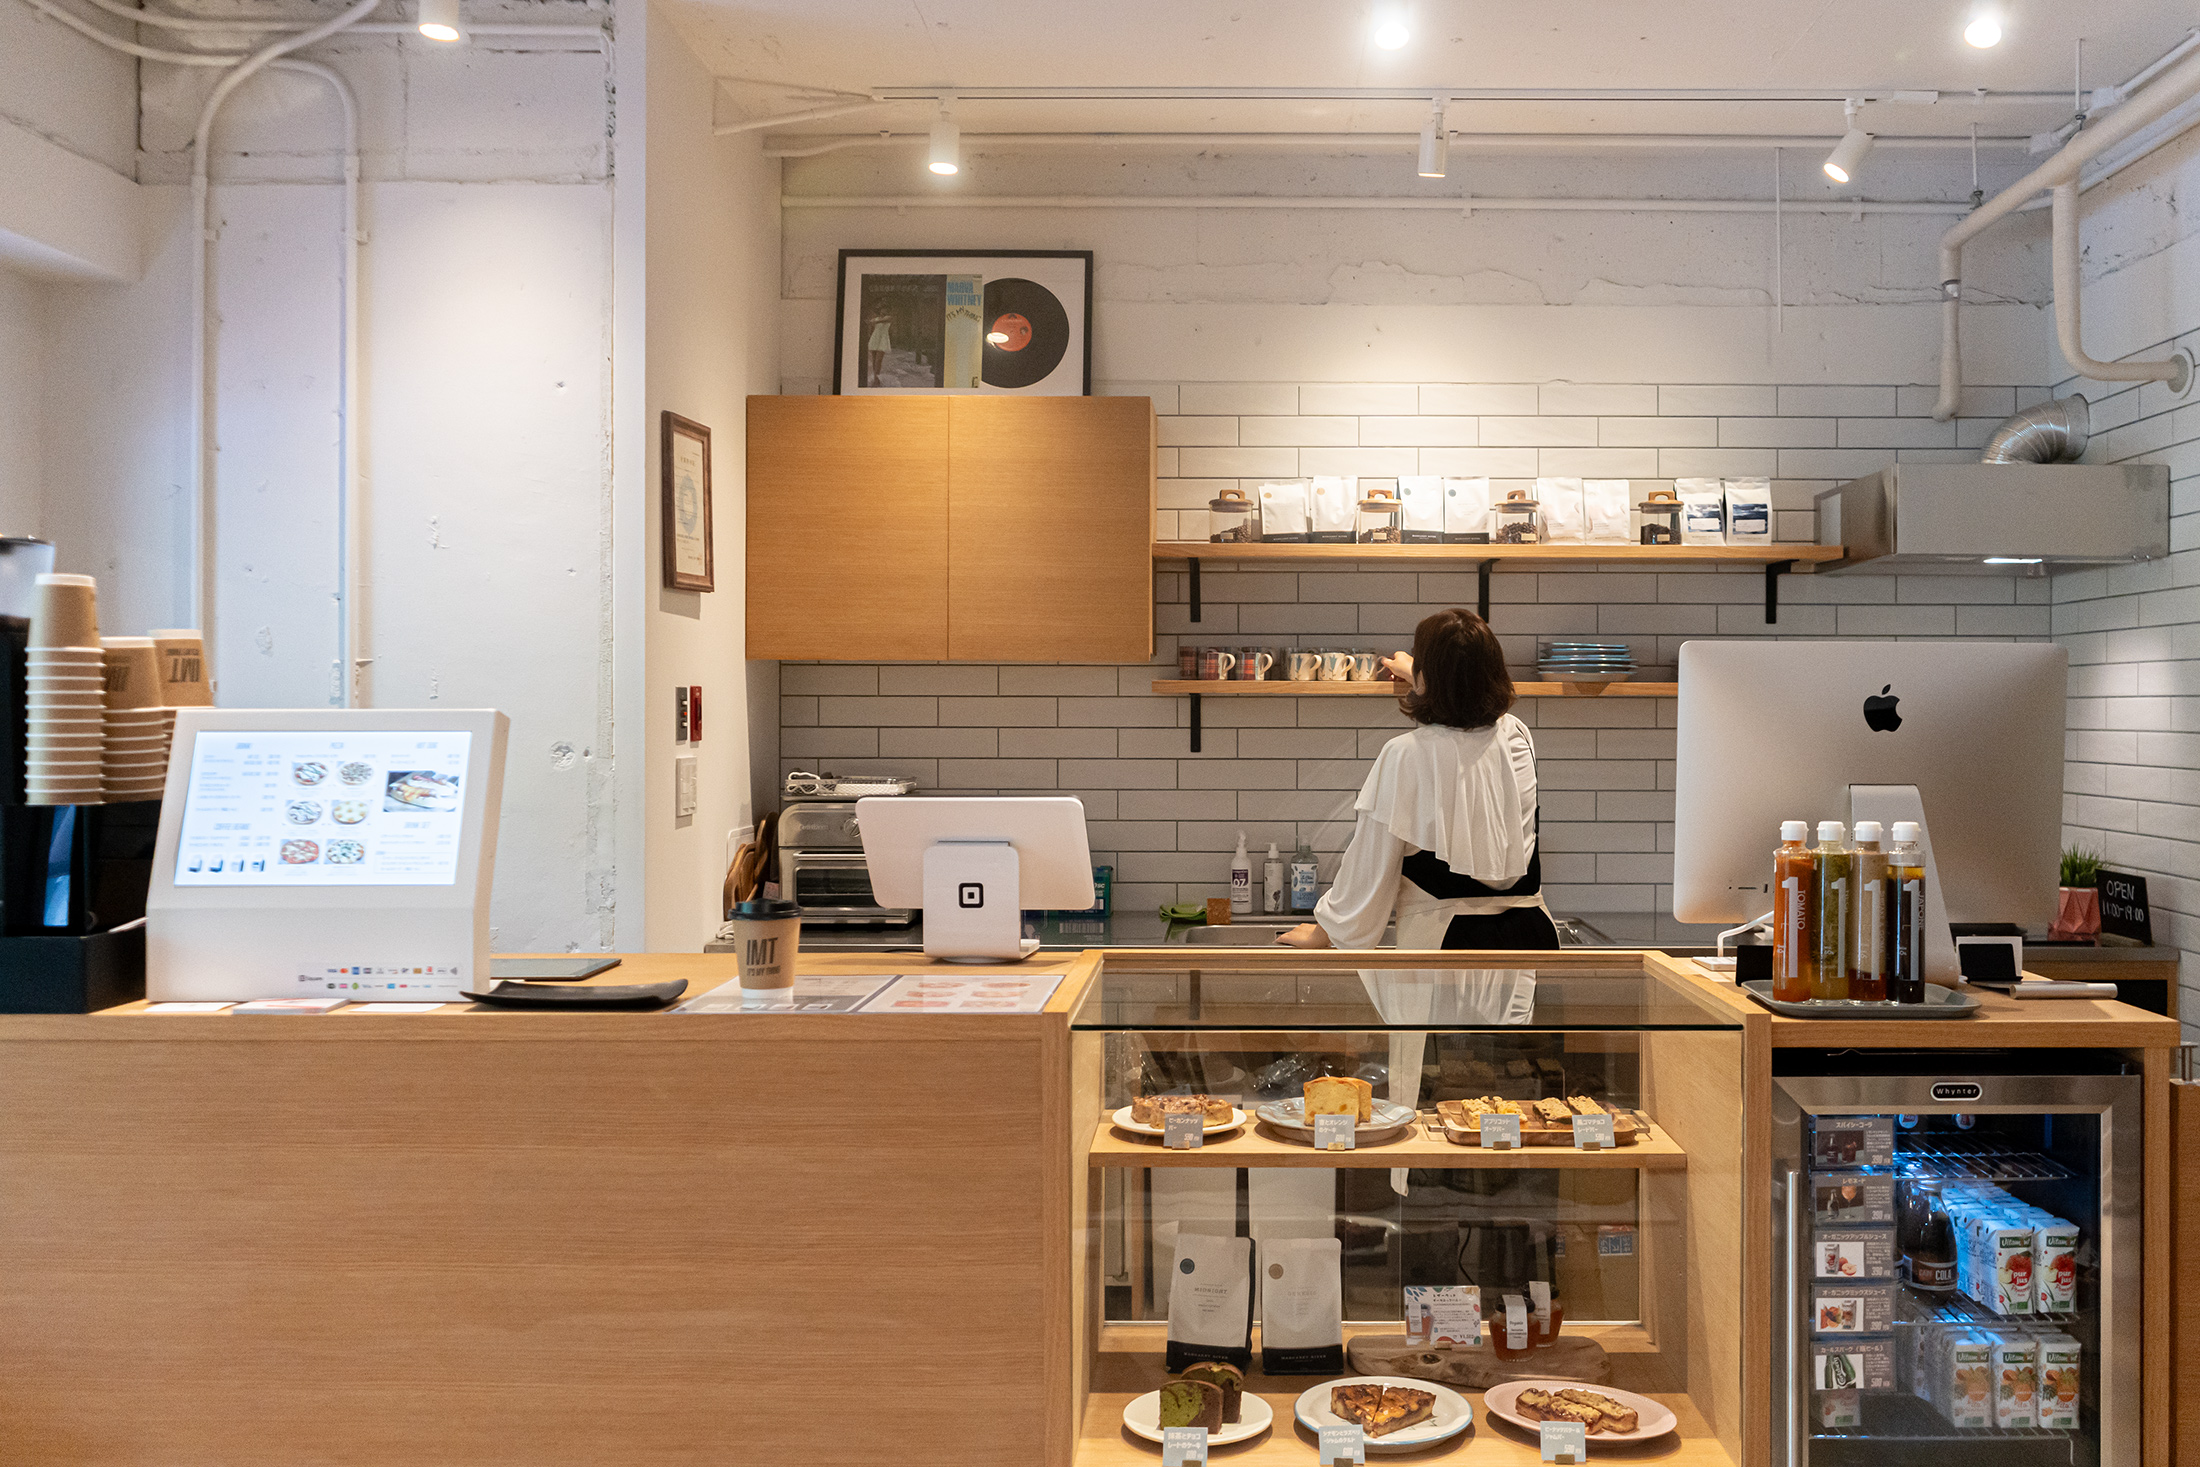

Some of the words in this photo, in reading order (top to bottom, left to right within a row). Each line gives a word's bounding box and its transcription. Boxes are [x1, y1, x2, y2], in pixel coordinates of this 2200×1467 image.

[947, 294, 981, 305] WHITNEY
[2106, 880, 2135, 900] OPEN
[1797, 890, 1806, 930] TOMATO
[746, 937, 778, 965] IMT
[1936, 1088, 1977, 1096] Whynter
[1935, 1269, 1952, 1281] COLA
